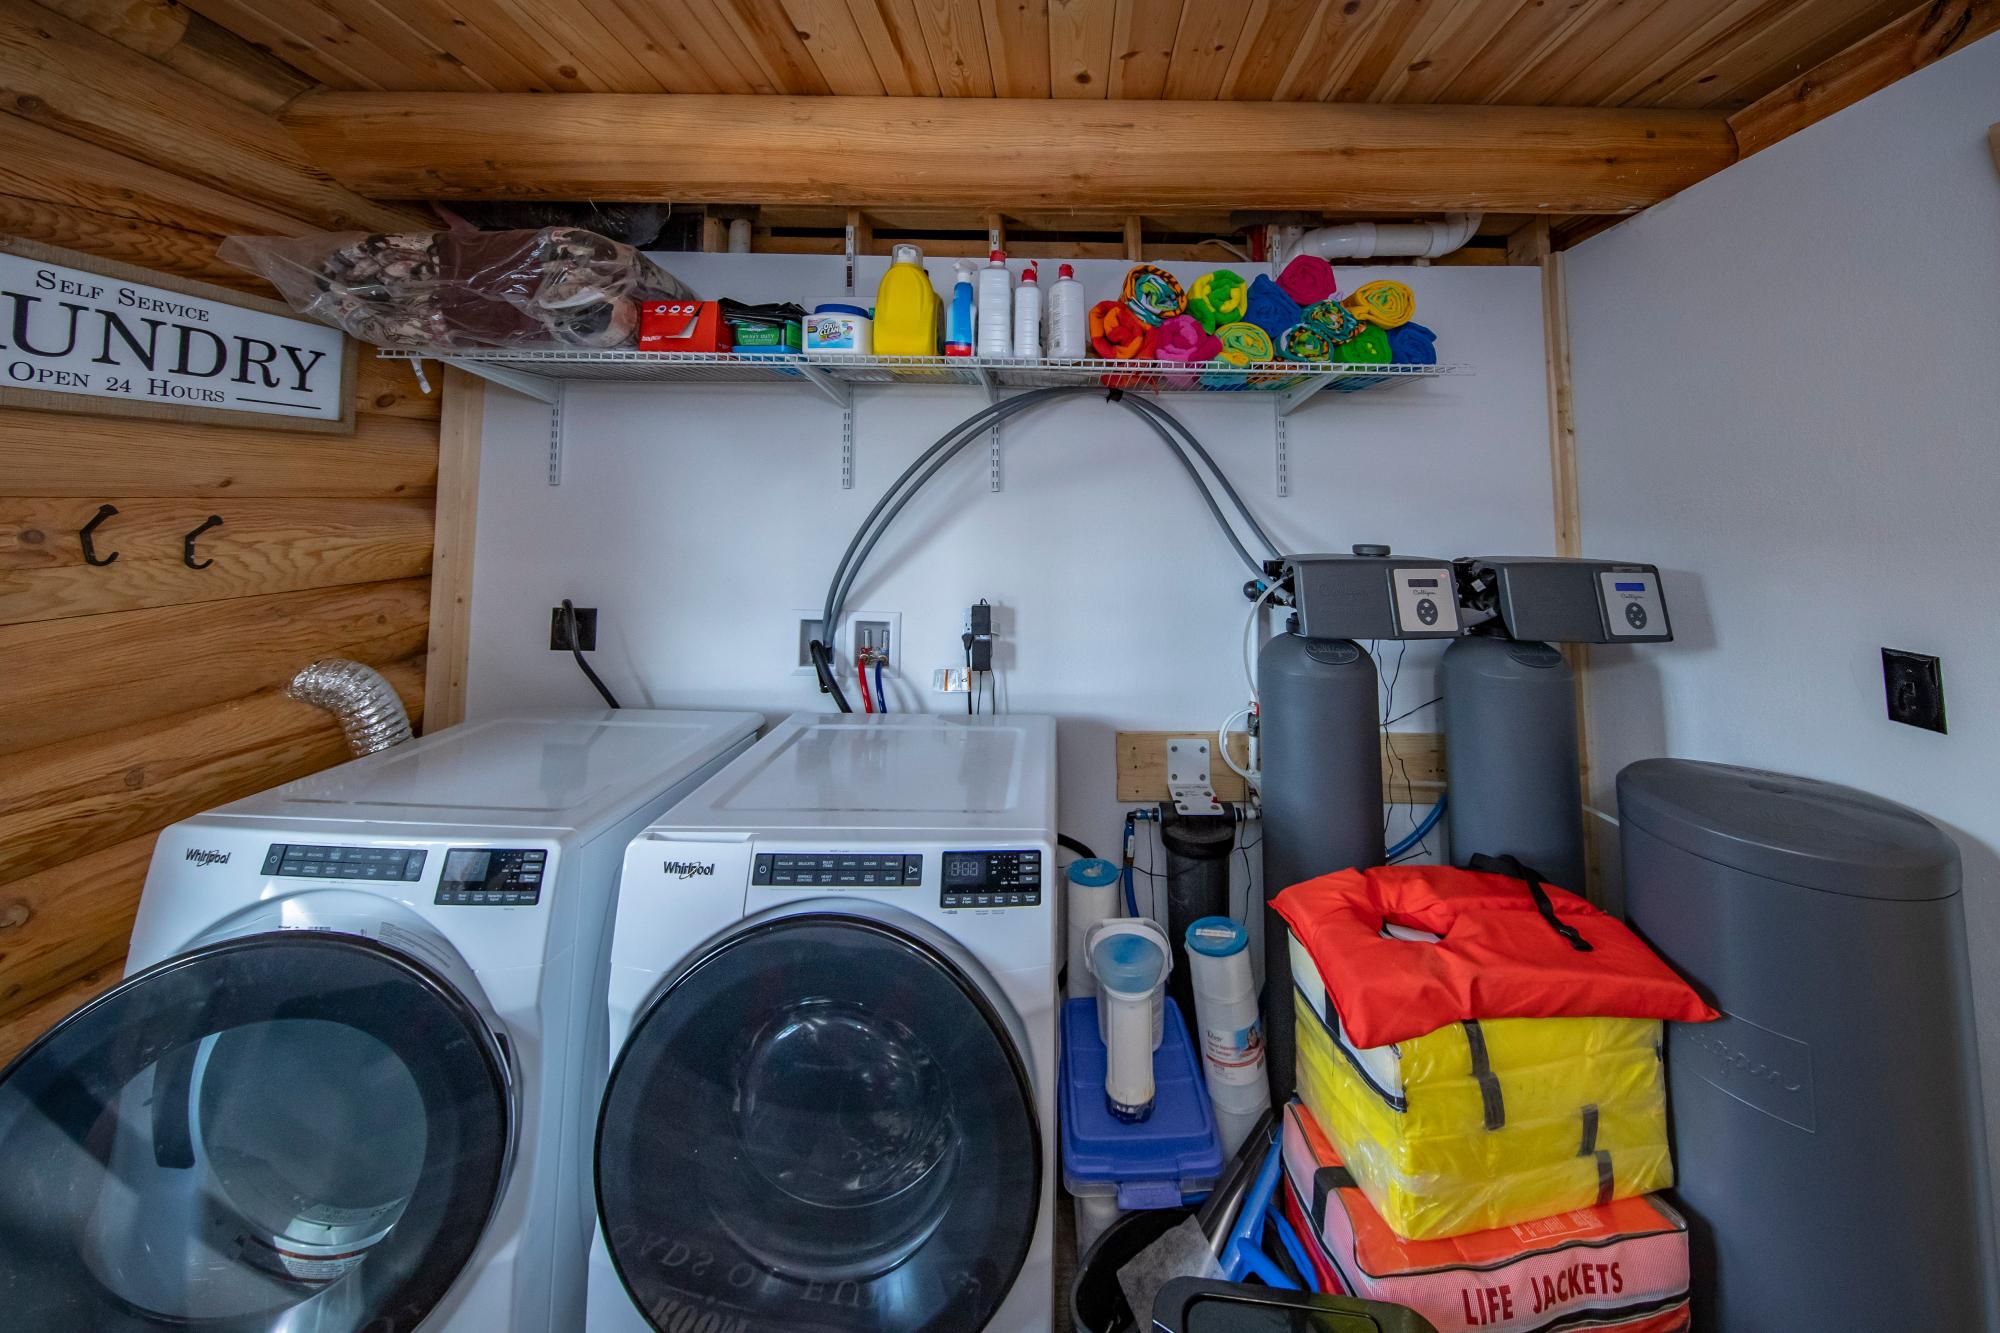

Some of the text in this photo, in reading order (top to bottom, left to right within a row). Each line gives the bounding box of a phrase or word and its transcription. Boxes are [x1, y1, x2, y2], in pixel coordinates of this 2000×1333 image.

[35, 270, 209, 323] SELF SERVICE
[0, 290, 326, 394] UNDRY
[8, 361, 225, 404] OPEN 24 HOURS
[185, 848, 232, 867] Whirlpool
[663, 861, 715, 880] Whirlpool
[1462, 1262, 1624, 1326] LIFE JACKETS
